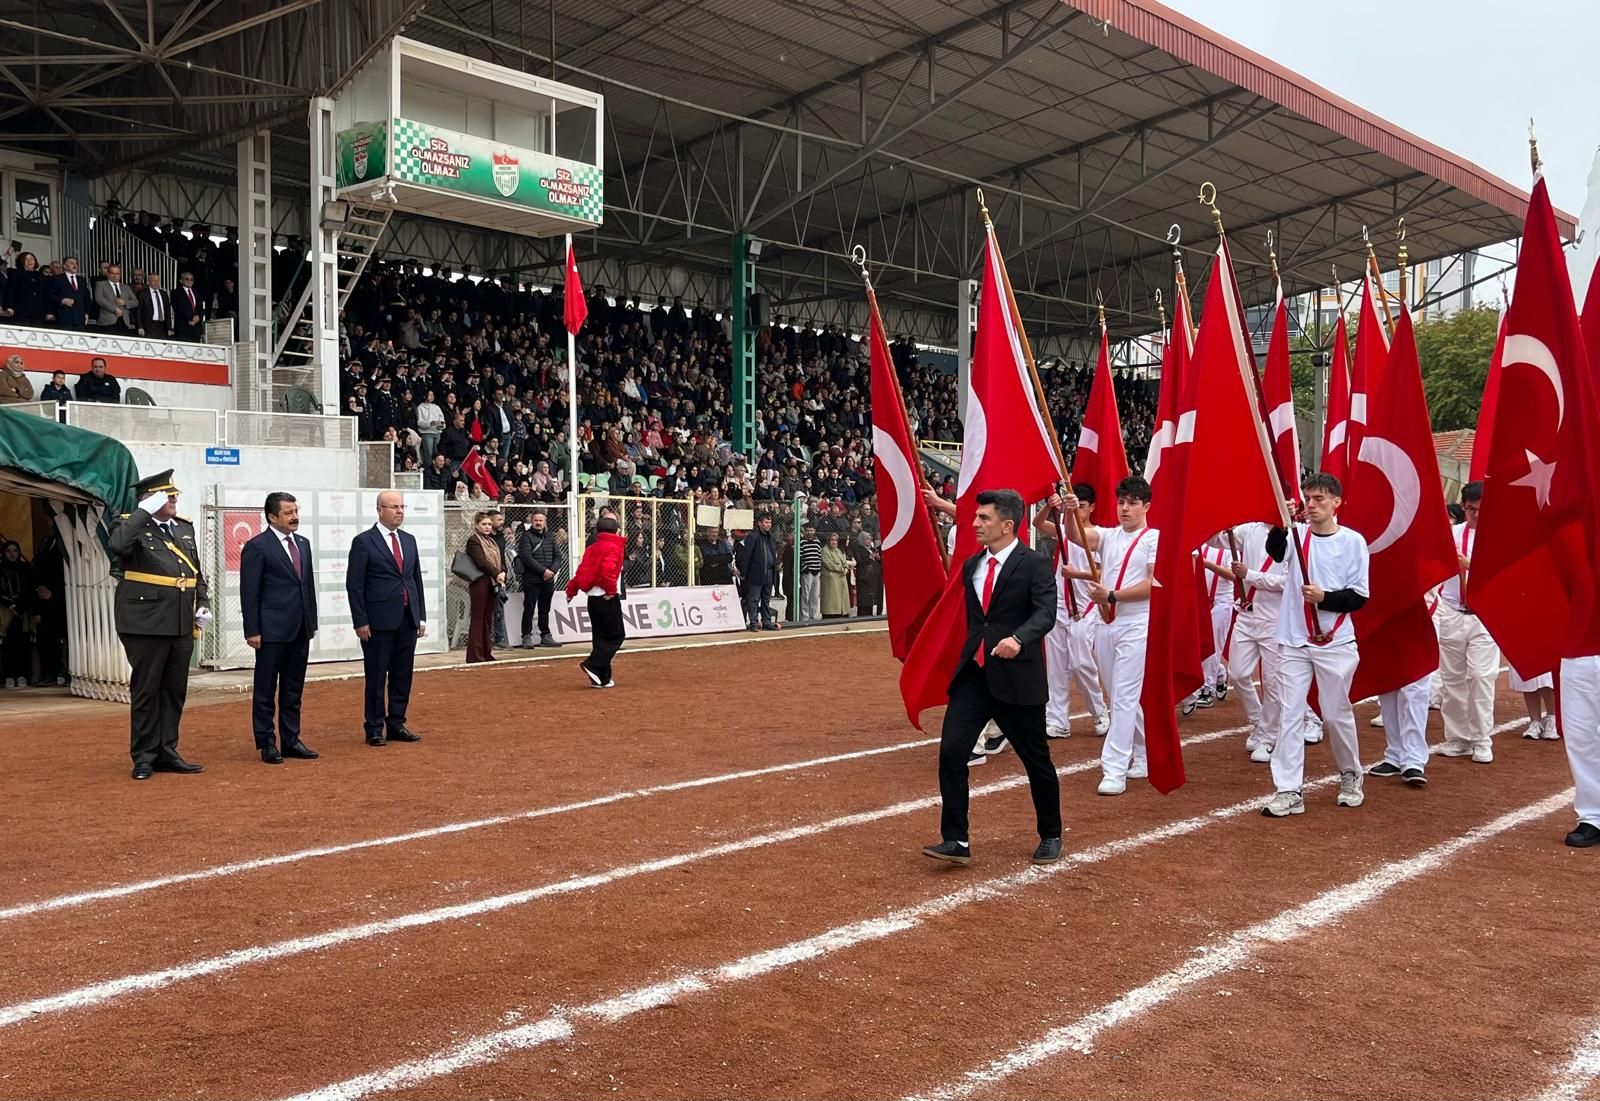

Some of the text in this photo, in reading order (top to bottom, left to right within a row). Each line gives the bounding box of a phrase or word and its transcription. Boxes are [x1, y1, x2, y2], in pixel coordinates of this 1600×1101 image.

[431, 138, 447, 151] SİZ
[412, 149, 469, 168] OLMAZSANIZ
[557, 168, 571, 180] SİZ
[540, 179, 590, 197] OLMAZSANIZ
